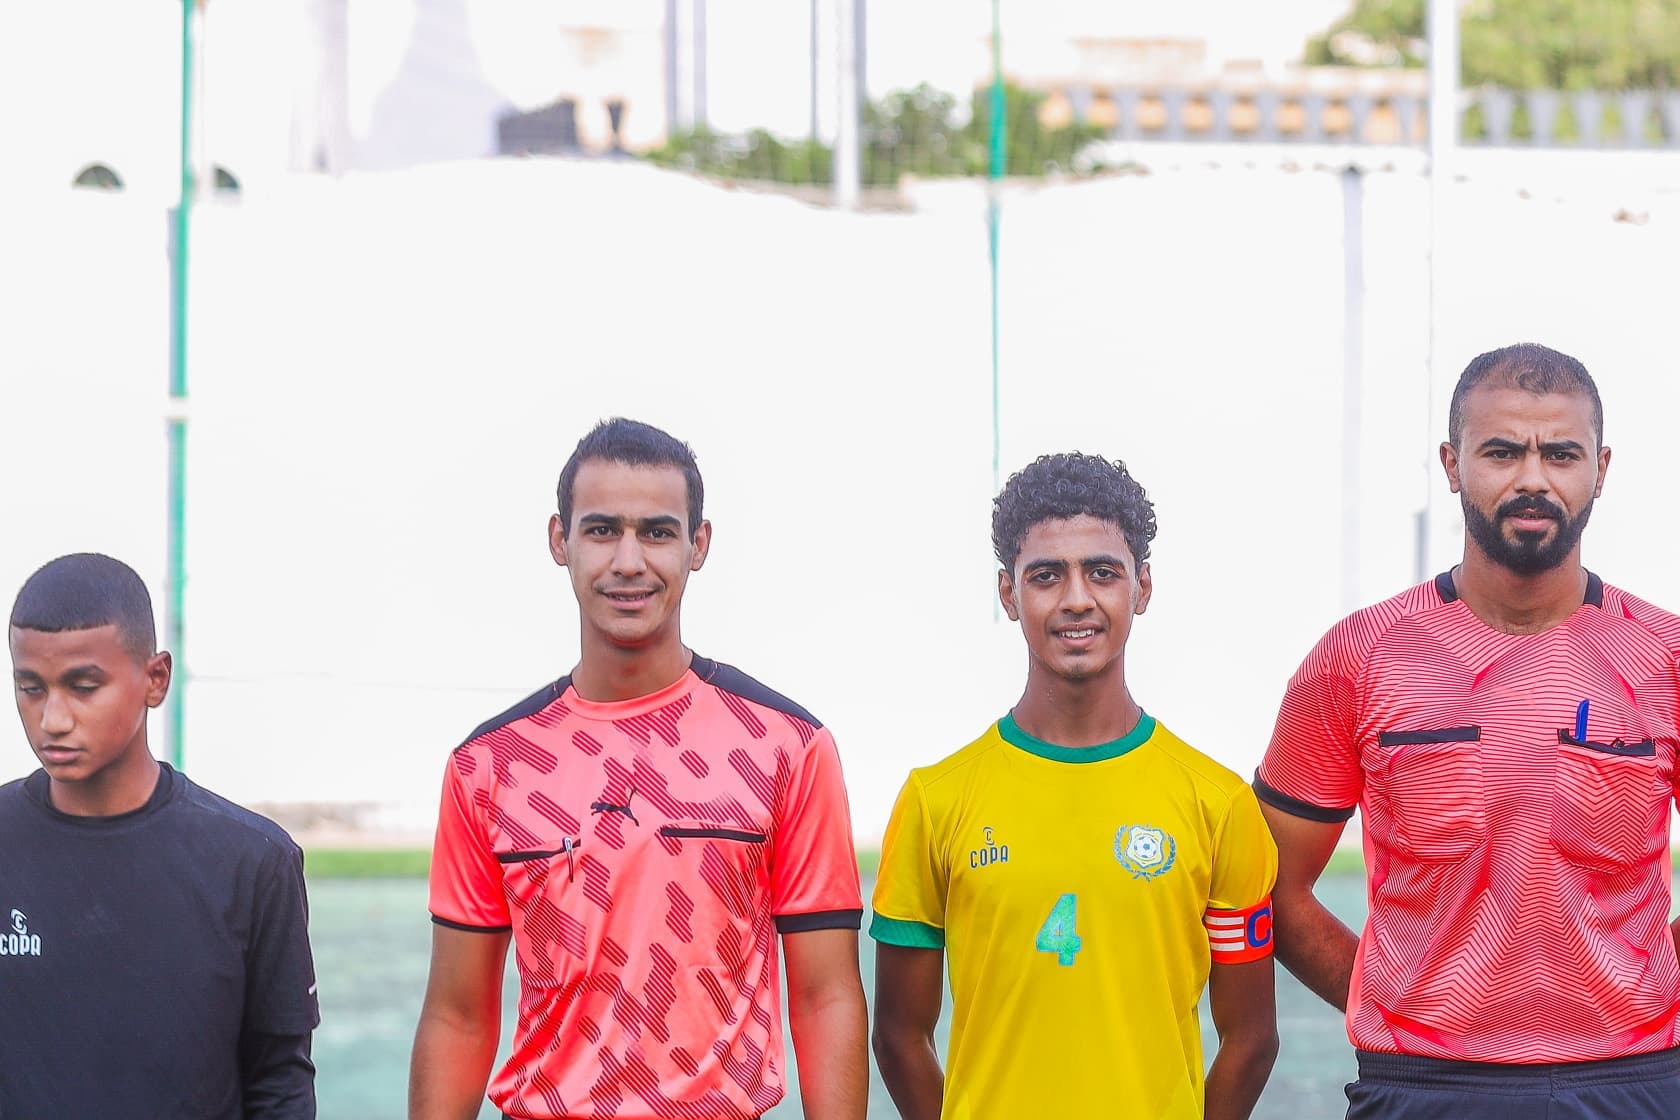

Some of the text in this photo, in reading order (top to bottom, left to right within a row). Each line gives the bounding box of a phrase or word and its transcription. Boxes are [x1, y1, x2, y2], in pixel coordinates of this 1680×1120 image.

[970, 845, 1008, 869] COPA
[1036, 893, 1082, 966] 4
[1247, 907, 1271, 948] C
[0, 933, 42, 956] COPA
